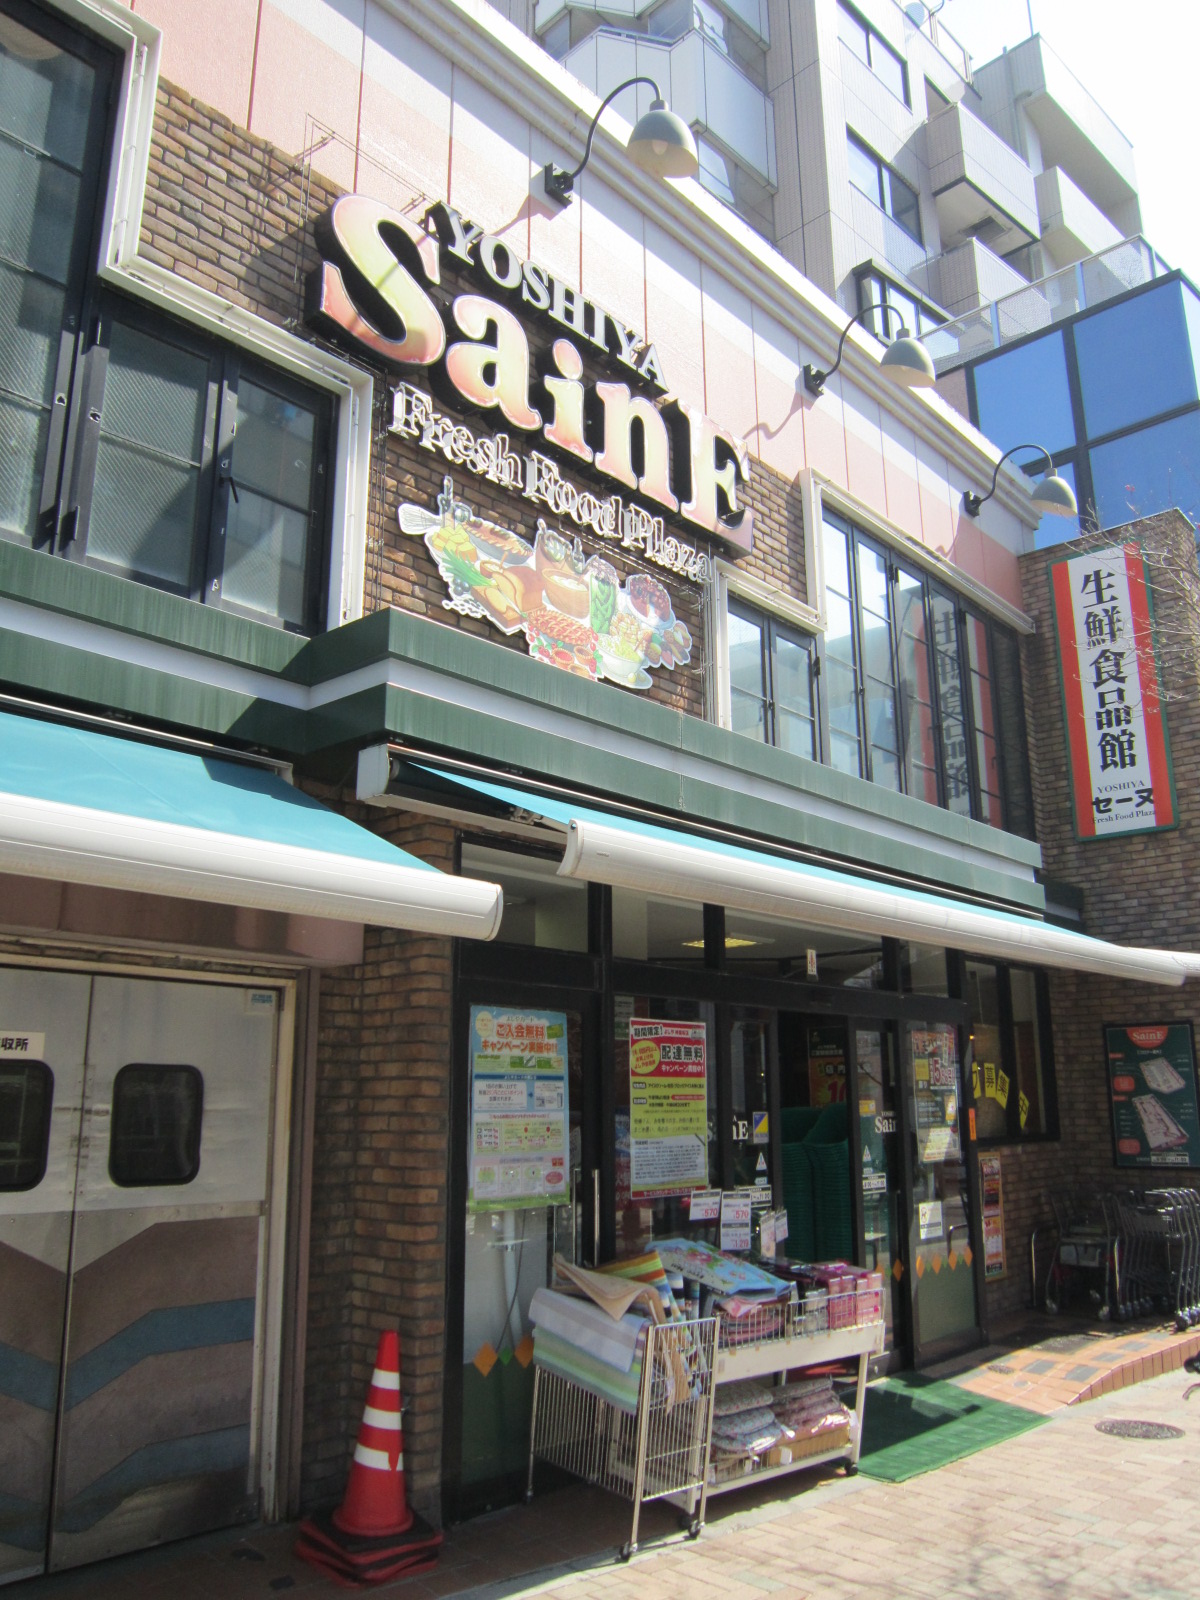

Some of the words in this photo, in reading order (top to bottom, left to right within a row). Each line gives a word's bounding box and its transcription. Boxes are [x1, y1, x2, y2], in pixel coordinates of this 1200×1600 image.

[430, 202, 669, 394] YOSHIYA
[320, 194, 753, 550] SainE
[388, 381, 523, 490] Fresh
[522, 450, 623, 540] Food
[622, 503, 714, 584] Plaza
[1080, 568, 1137, 773] 生鮮食品館
[1097, 779, 1145, 794] YOSHIYA
[1092, 787, 1154, 814] セーヌ
[1115, 811, 1134, 821] Food
[496, 1023, 545, 1040] ご入会無料
[1132, 1030, 1165, 1041] SainE
[0, 1037, 29, 1052] 収所
[661, 1045, 704, 1061] 配達無料
